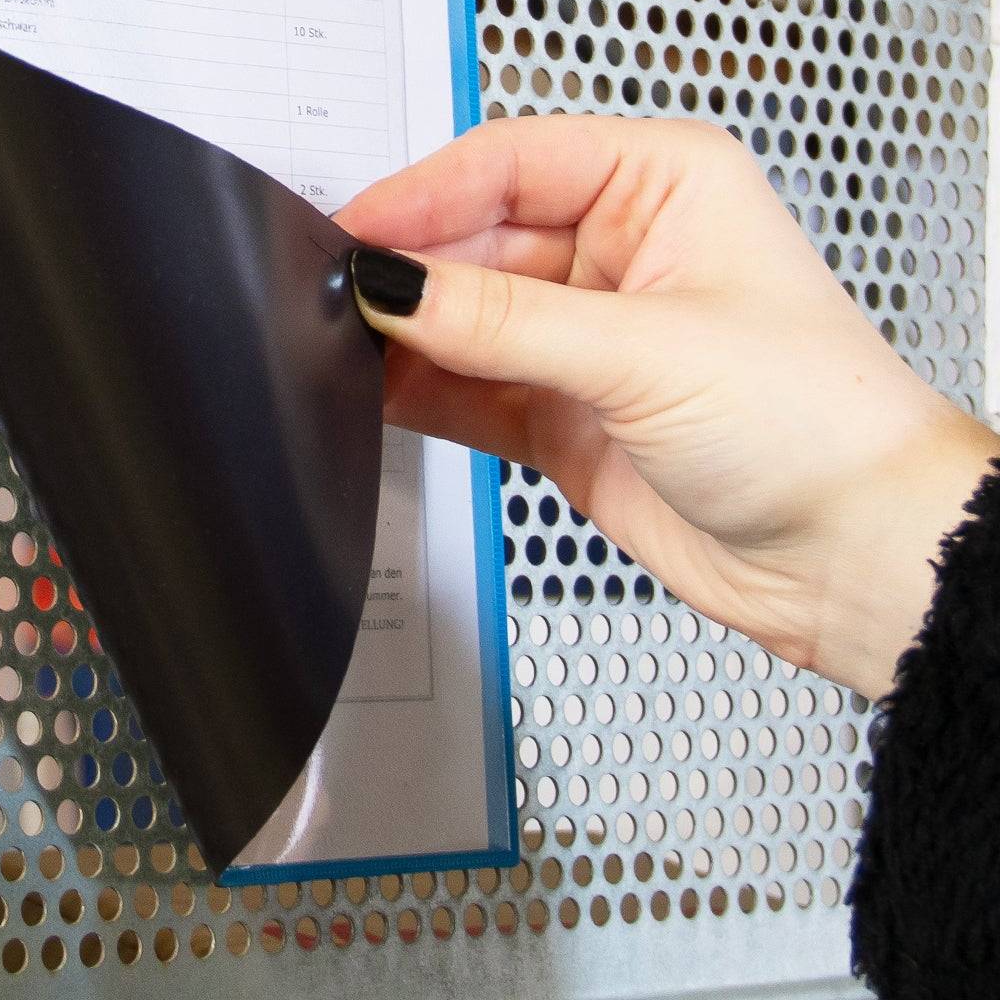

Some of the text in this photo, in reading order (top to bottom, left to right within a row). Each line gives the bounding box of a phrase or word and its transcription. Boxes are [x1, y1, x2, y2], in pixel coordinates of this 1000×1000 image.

[294, 26, 327, 40] 10 Stk.
[306, 106, 328, 118] Rolle
[309, 185, 328, 198] Stk.
[366, 591, 402, 601] ummer.
